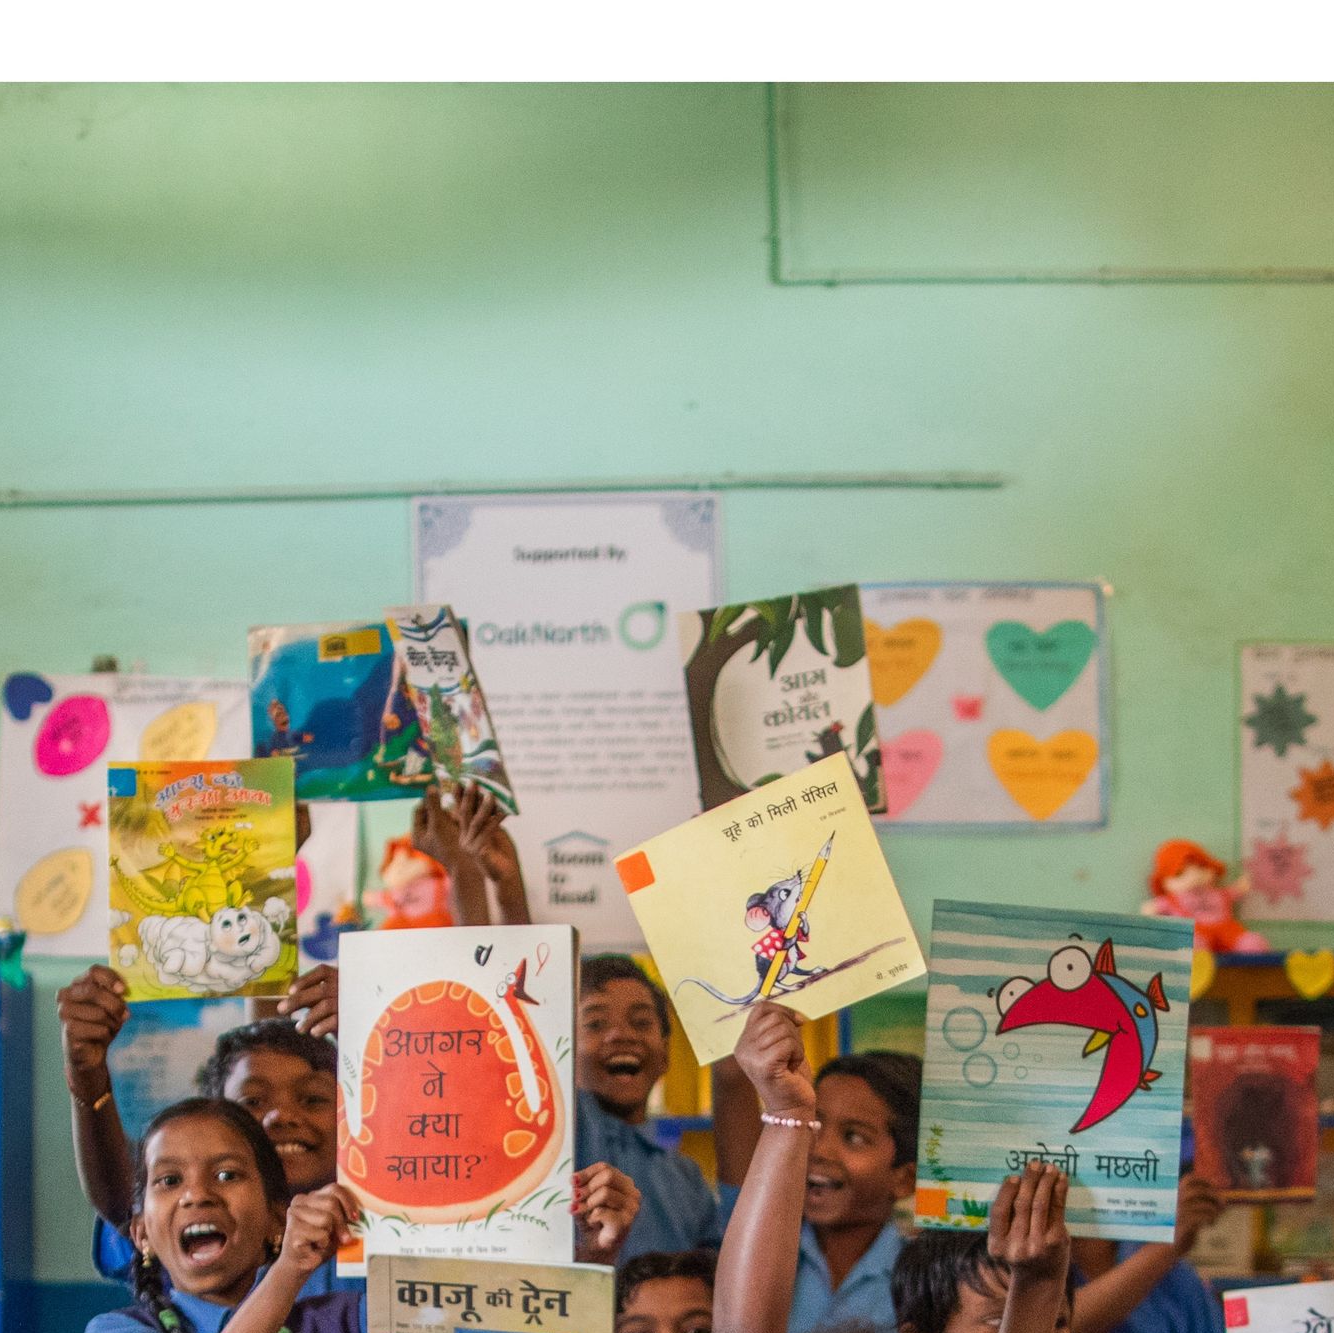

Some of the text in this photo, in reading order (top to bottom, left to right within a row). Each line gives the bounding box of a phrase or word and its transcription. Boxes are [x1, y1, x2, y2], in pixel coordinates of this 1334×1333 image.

[513, 546, 599, 564] Supported
[476, 622, 611, 646] OakNorth
[780, 668, 826, 692] आम
[763, 700, 830, 726] कोयल
[721, 781, 839, 842] चूहे को मिली पेंसिल
[385, 1028, 485, 1057] अजगर
[421, 1060, 447, 1099] ने
[406, 1112, 464, 1139] क्या
[385, 1154, 483, 1182] खाया?
[1095, 1149, 1160, 1182] मछली
[396, 1279, 572, 1326] काजू की ट्रेन
